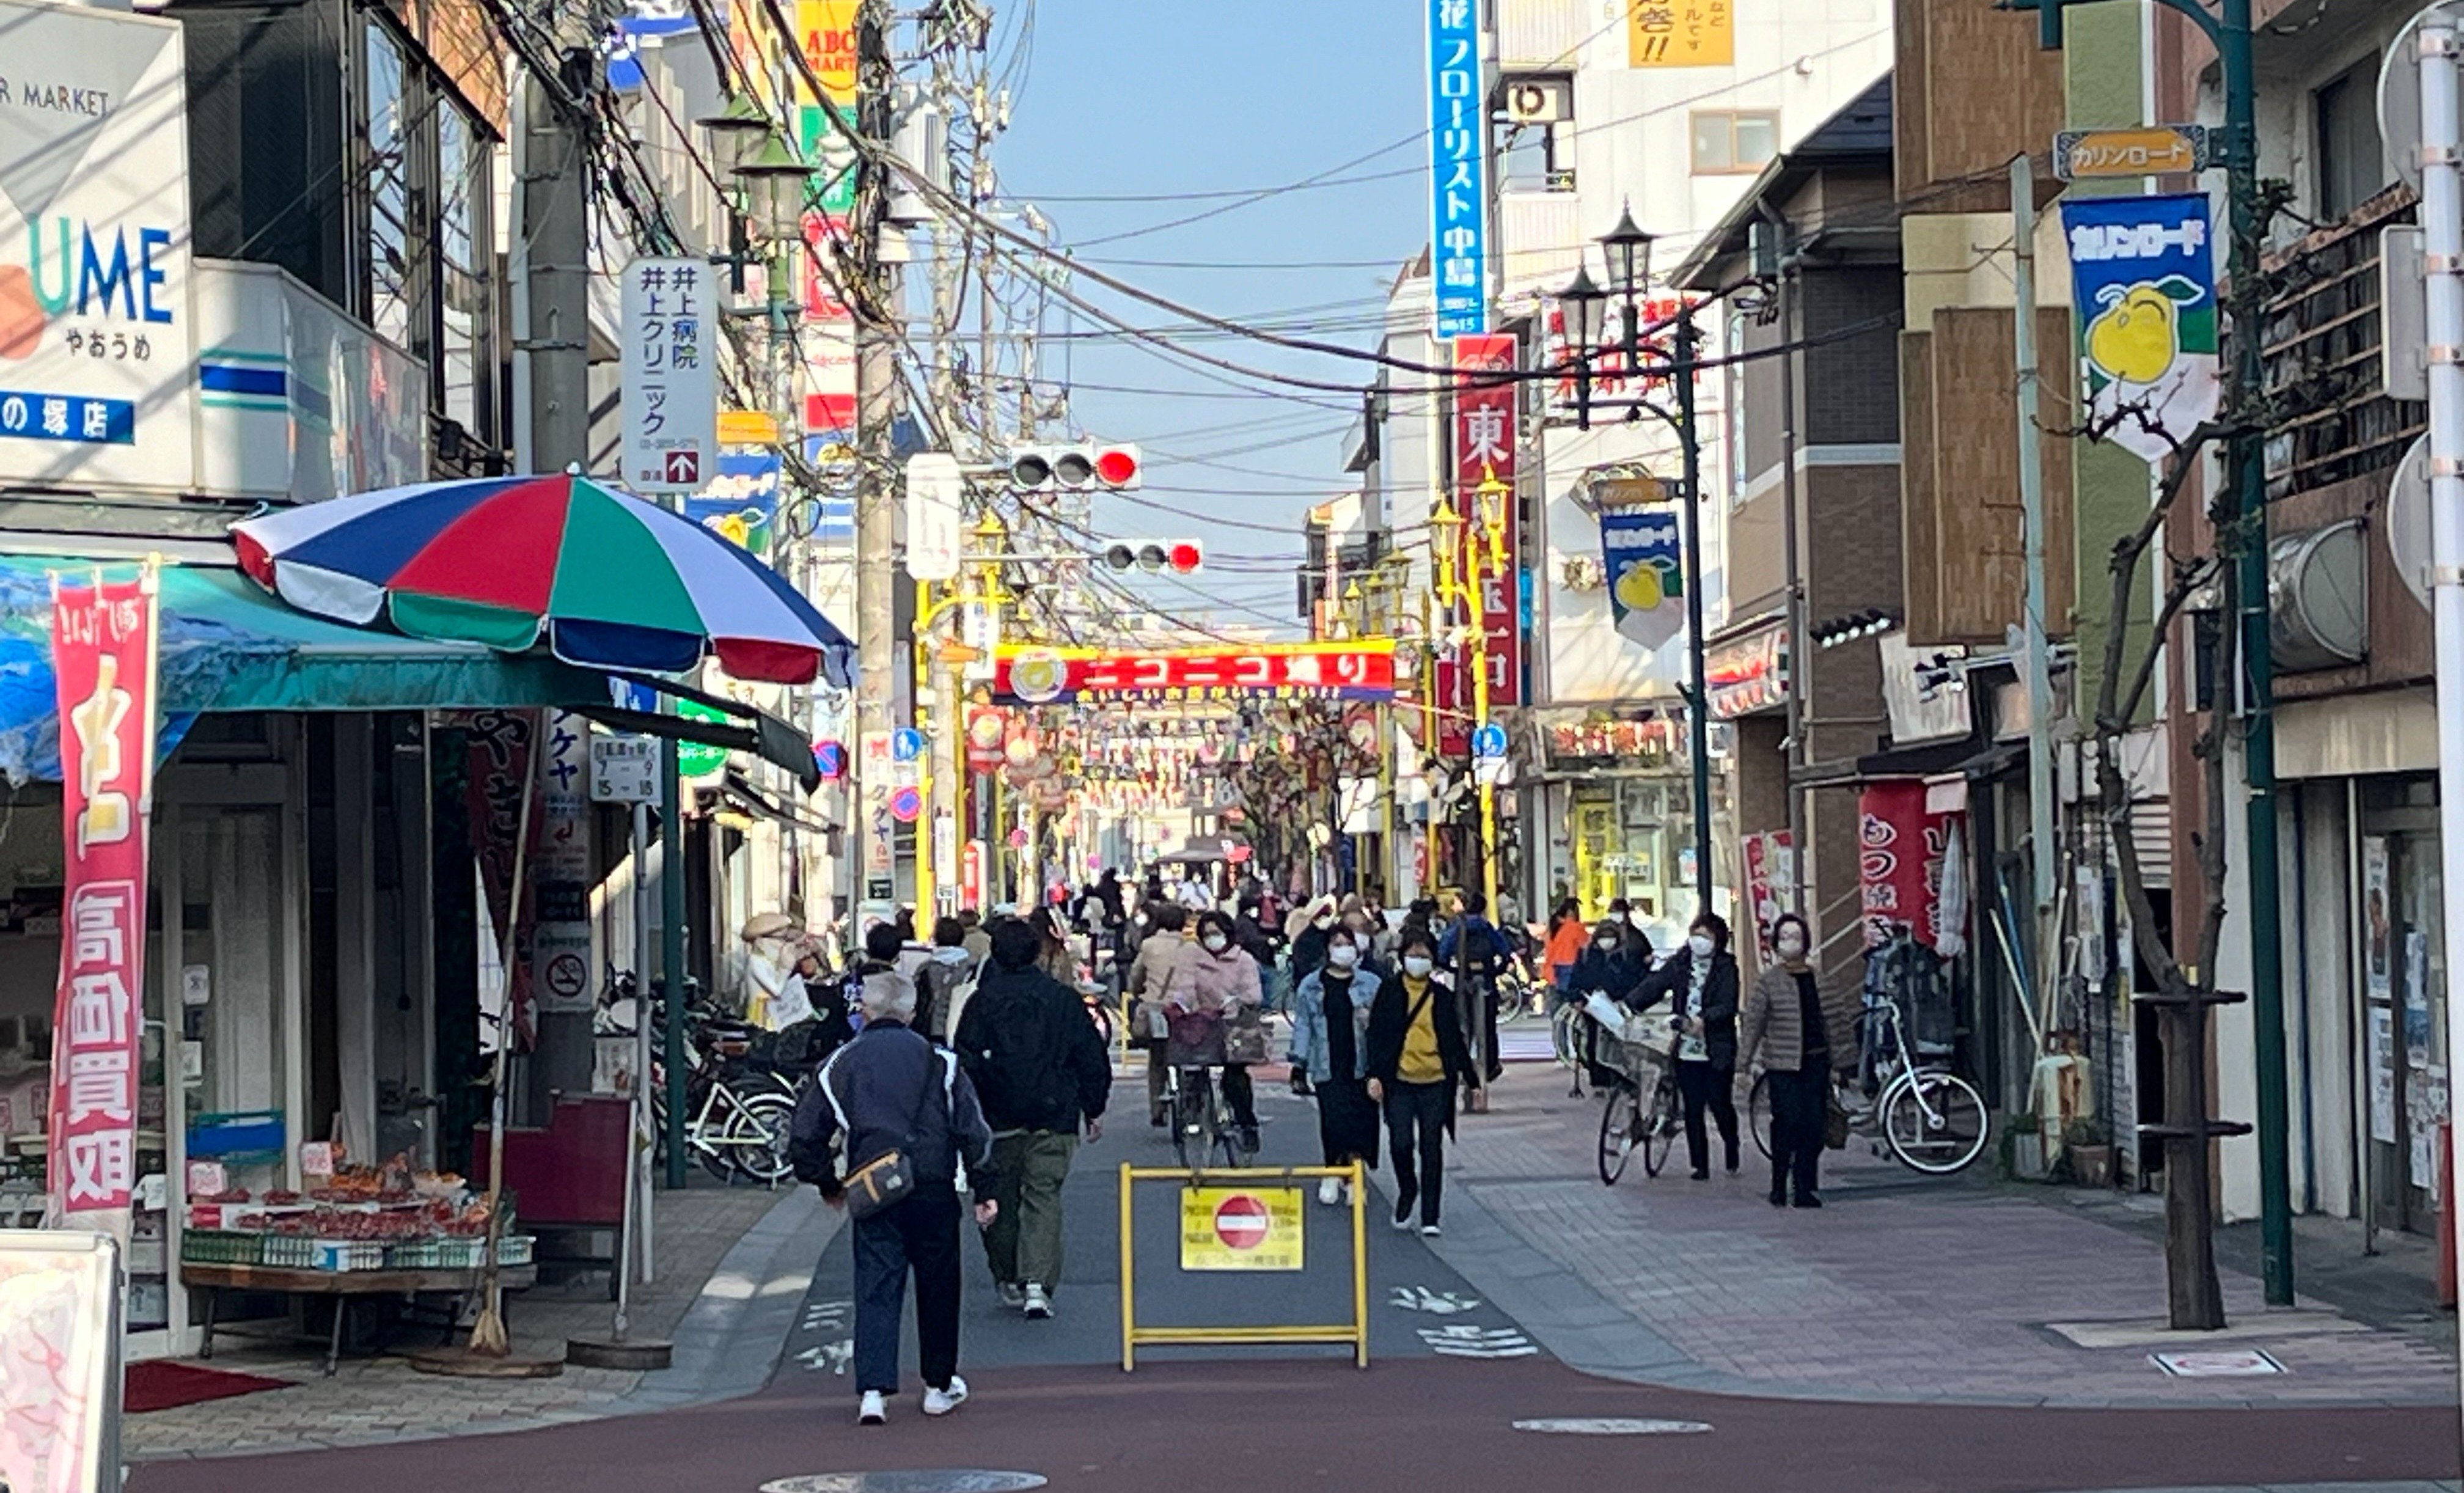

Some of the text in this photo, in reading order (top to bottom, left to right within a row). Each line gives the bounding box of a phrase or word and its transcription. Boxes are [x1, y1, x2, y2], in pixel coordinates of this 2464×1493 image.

[806, 31, 856, 54] ABC
[24, 84, 110, 117] MARKET
[2072, 143, 2185, 168] カリンロード
[672, 267, 698, 370] 井上病院
[65, 329, 151, 362] やおうめ
[641, 267, 667, 436] 井上クリニック
[2, 398, 108, 438] の塚店
[1084, 655, 1367, 686] ニコニコ通り
